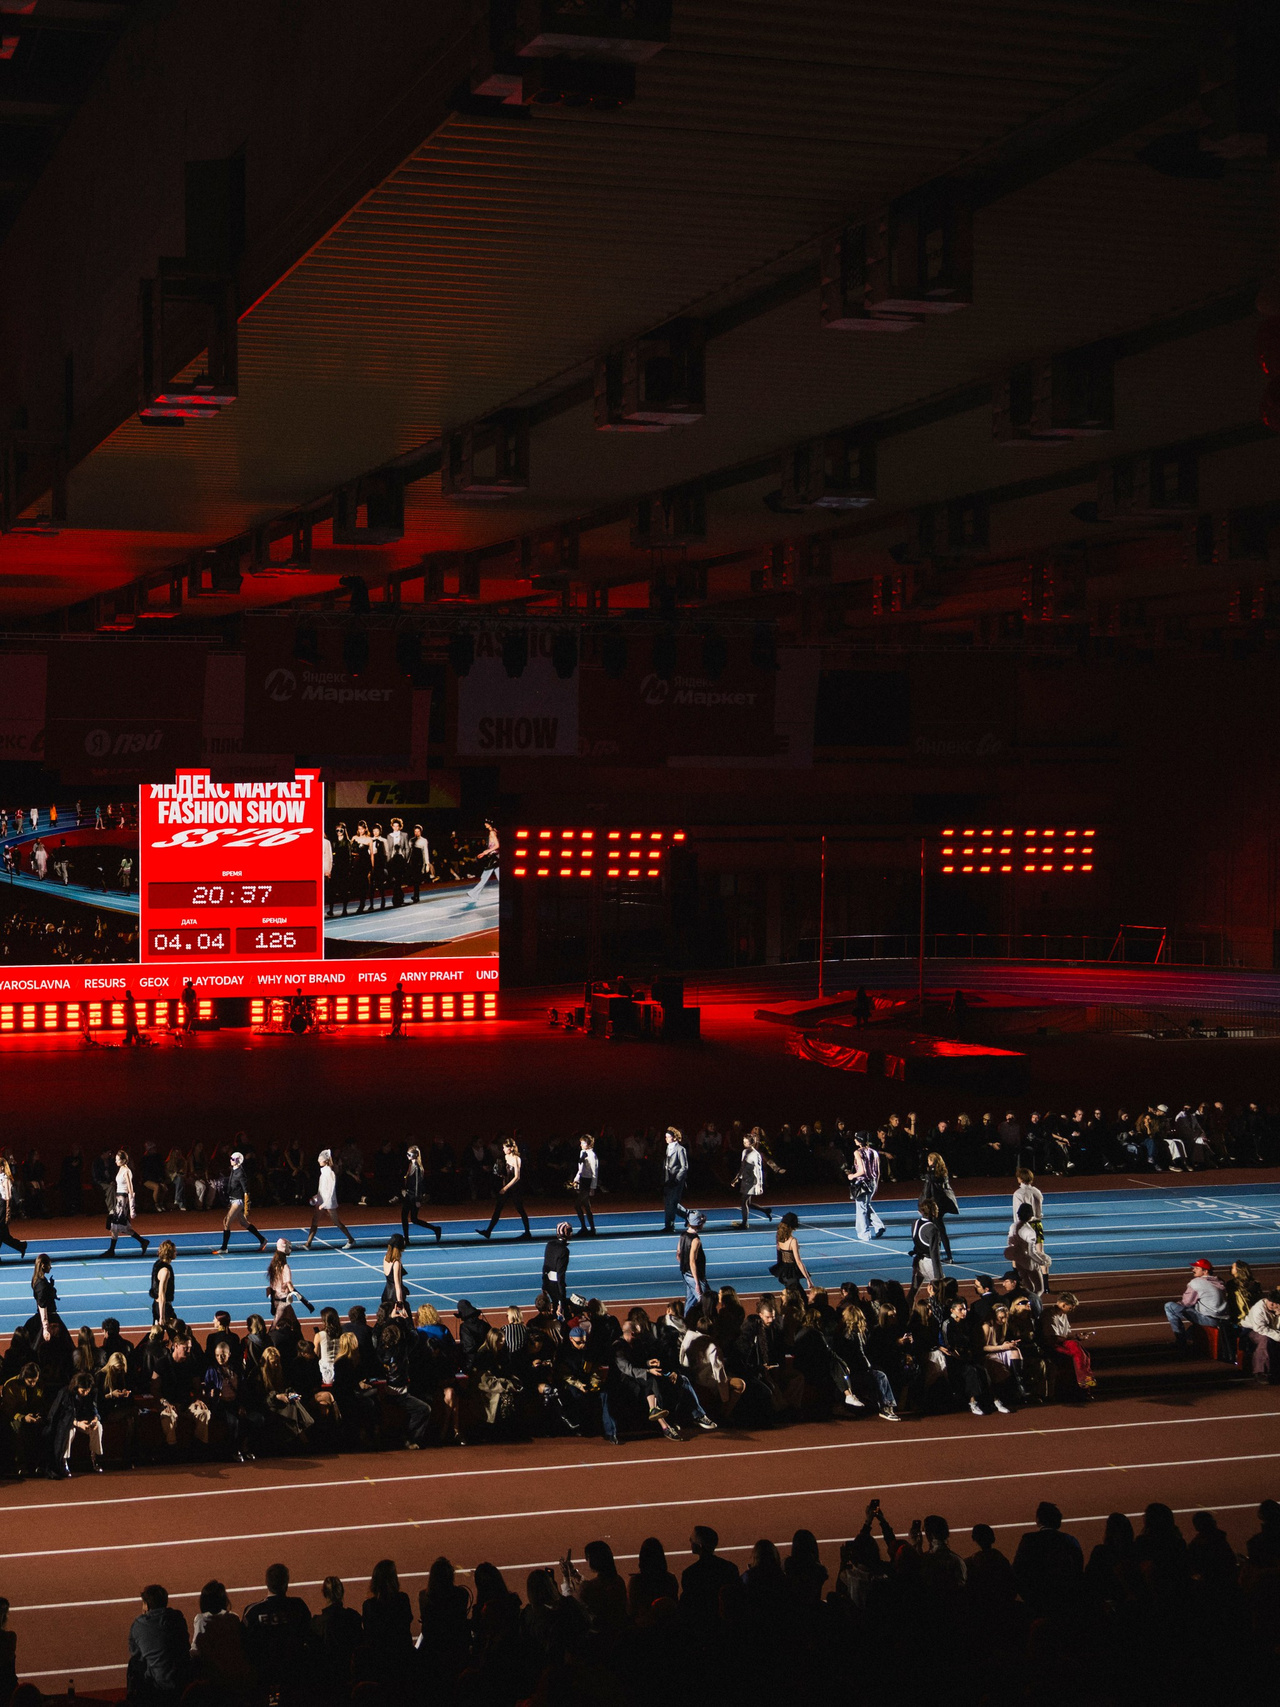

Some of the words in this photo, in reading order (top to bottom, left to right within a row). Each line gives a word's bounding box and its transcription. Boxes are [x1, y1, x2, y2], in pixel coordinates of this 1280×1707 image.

[302, 670, 347, 684] Яндекс
[301, 685, 394, 704] Маркет
[673, 690, 758, 707] Маркет
[478, 716, 558, 749] SHOW
[150, 774, 230, 802] ЯНДЕКС
[234, 774, 314, 798] МАРКЕТ
[158, 801, 242, 824] FASHION
[246, 801, 305, 824] SHOW
[151, 827, 314, 848] SS'26
[192, 886, 272, 904] 20:37
[154, 933, 225, 950] 04.04
[255, 932, 296, 949] 126
[84, 978, 126, 988] RESURS
[139, 977, 169, 988] GEOX
[257, 974, 282, 985] WHY
[284, 974, 307, 984] NOT
[309, 973, 345, 984] BRAND
[358, 972, 387, 982] PITAS
[399, 971, 427, 982] ARNY
[430, 971, 464, 981] PRAHT
[476, 970, 499, 980] UND
